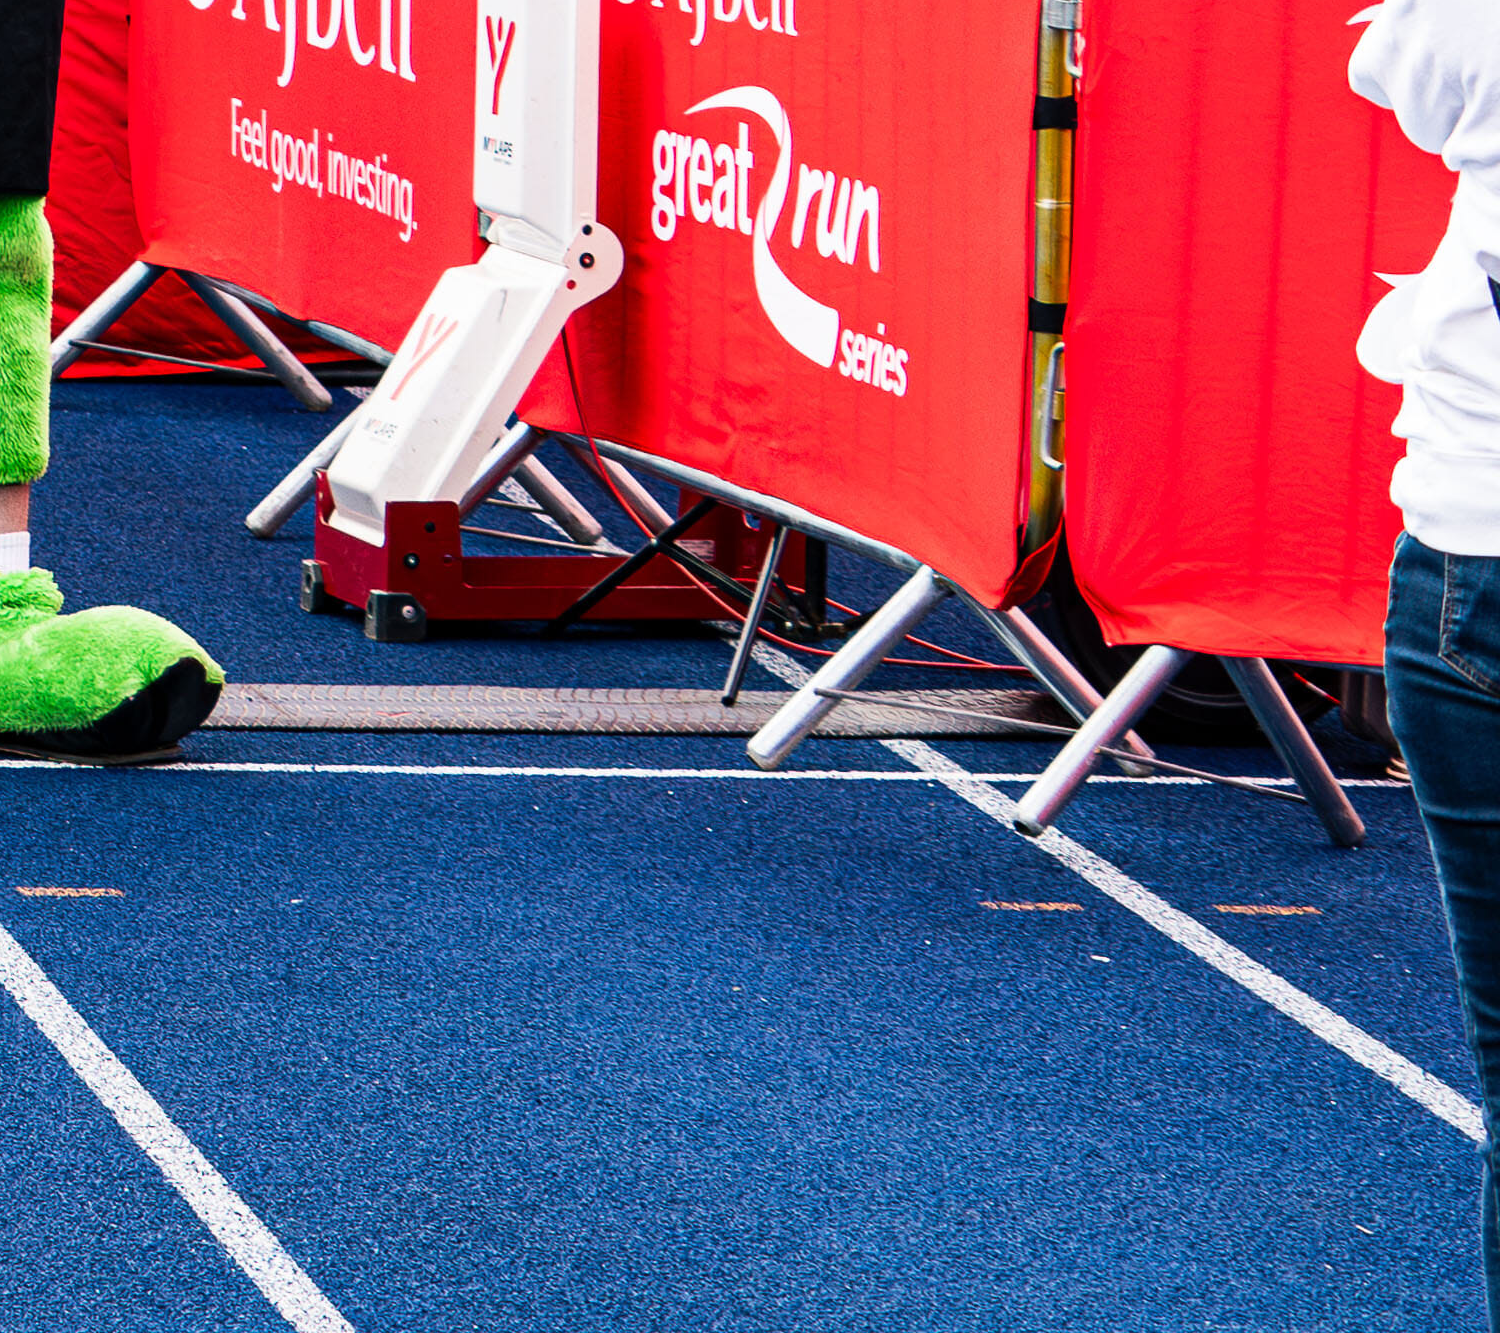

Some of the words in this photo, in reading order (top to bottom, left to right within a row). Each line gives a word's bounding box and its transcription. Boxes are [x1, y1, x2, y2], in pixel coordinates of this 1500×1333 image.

[231, 97, 268, 171] Feel
[270, 128, 323, 198] good,
[327, 132, 418, 243] investing.
[652, 120, 754, 241] great
[792, 161, 881, 273] run
[839, 322, 909, 398] series
